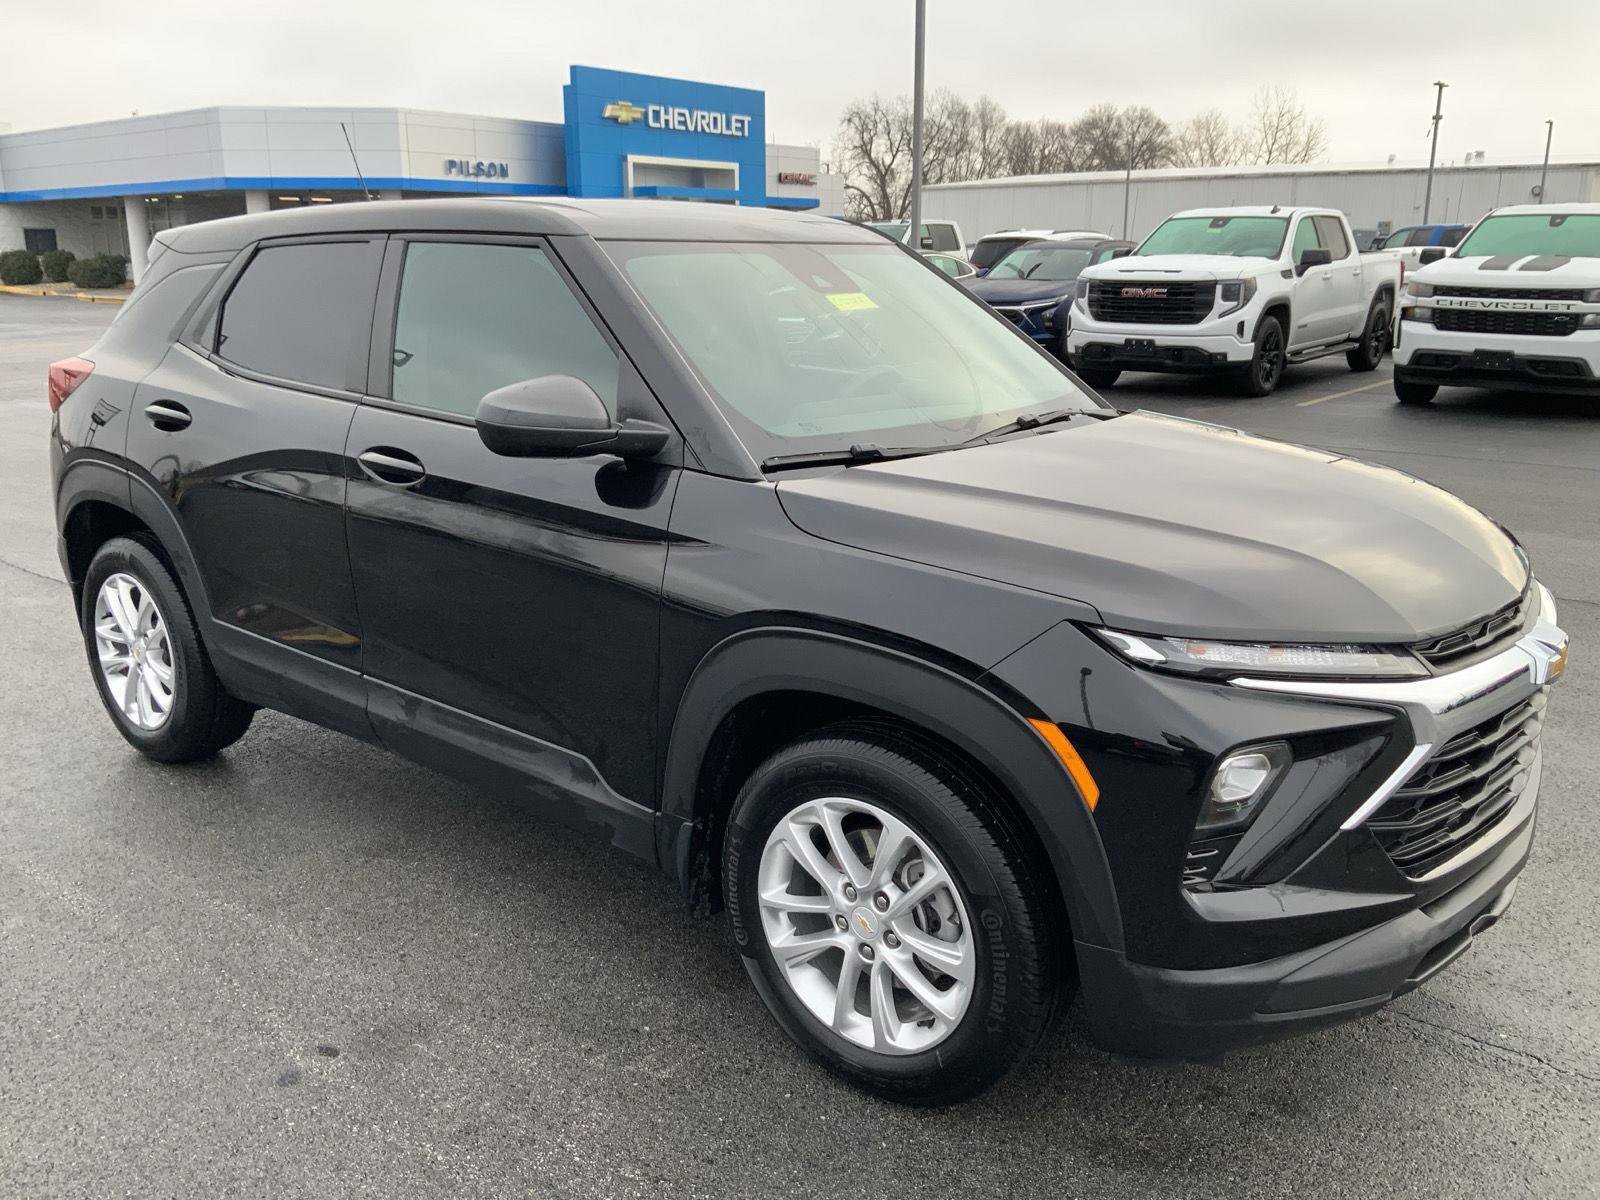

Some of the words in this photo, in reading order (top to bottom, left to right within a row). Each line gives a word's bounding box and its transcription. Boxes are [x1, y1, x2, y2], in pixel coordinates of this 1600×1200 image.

[647, 103, 752, 137] CHEVROLET
[447, 159, 509, 178] PILSON
[1121, 287, 1168, 299] GMC
[1436, 299, 1577, 311] CHEVROLET
